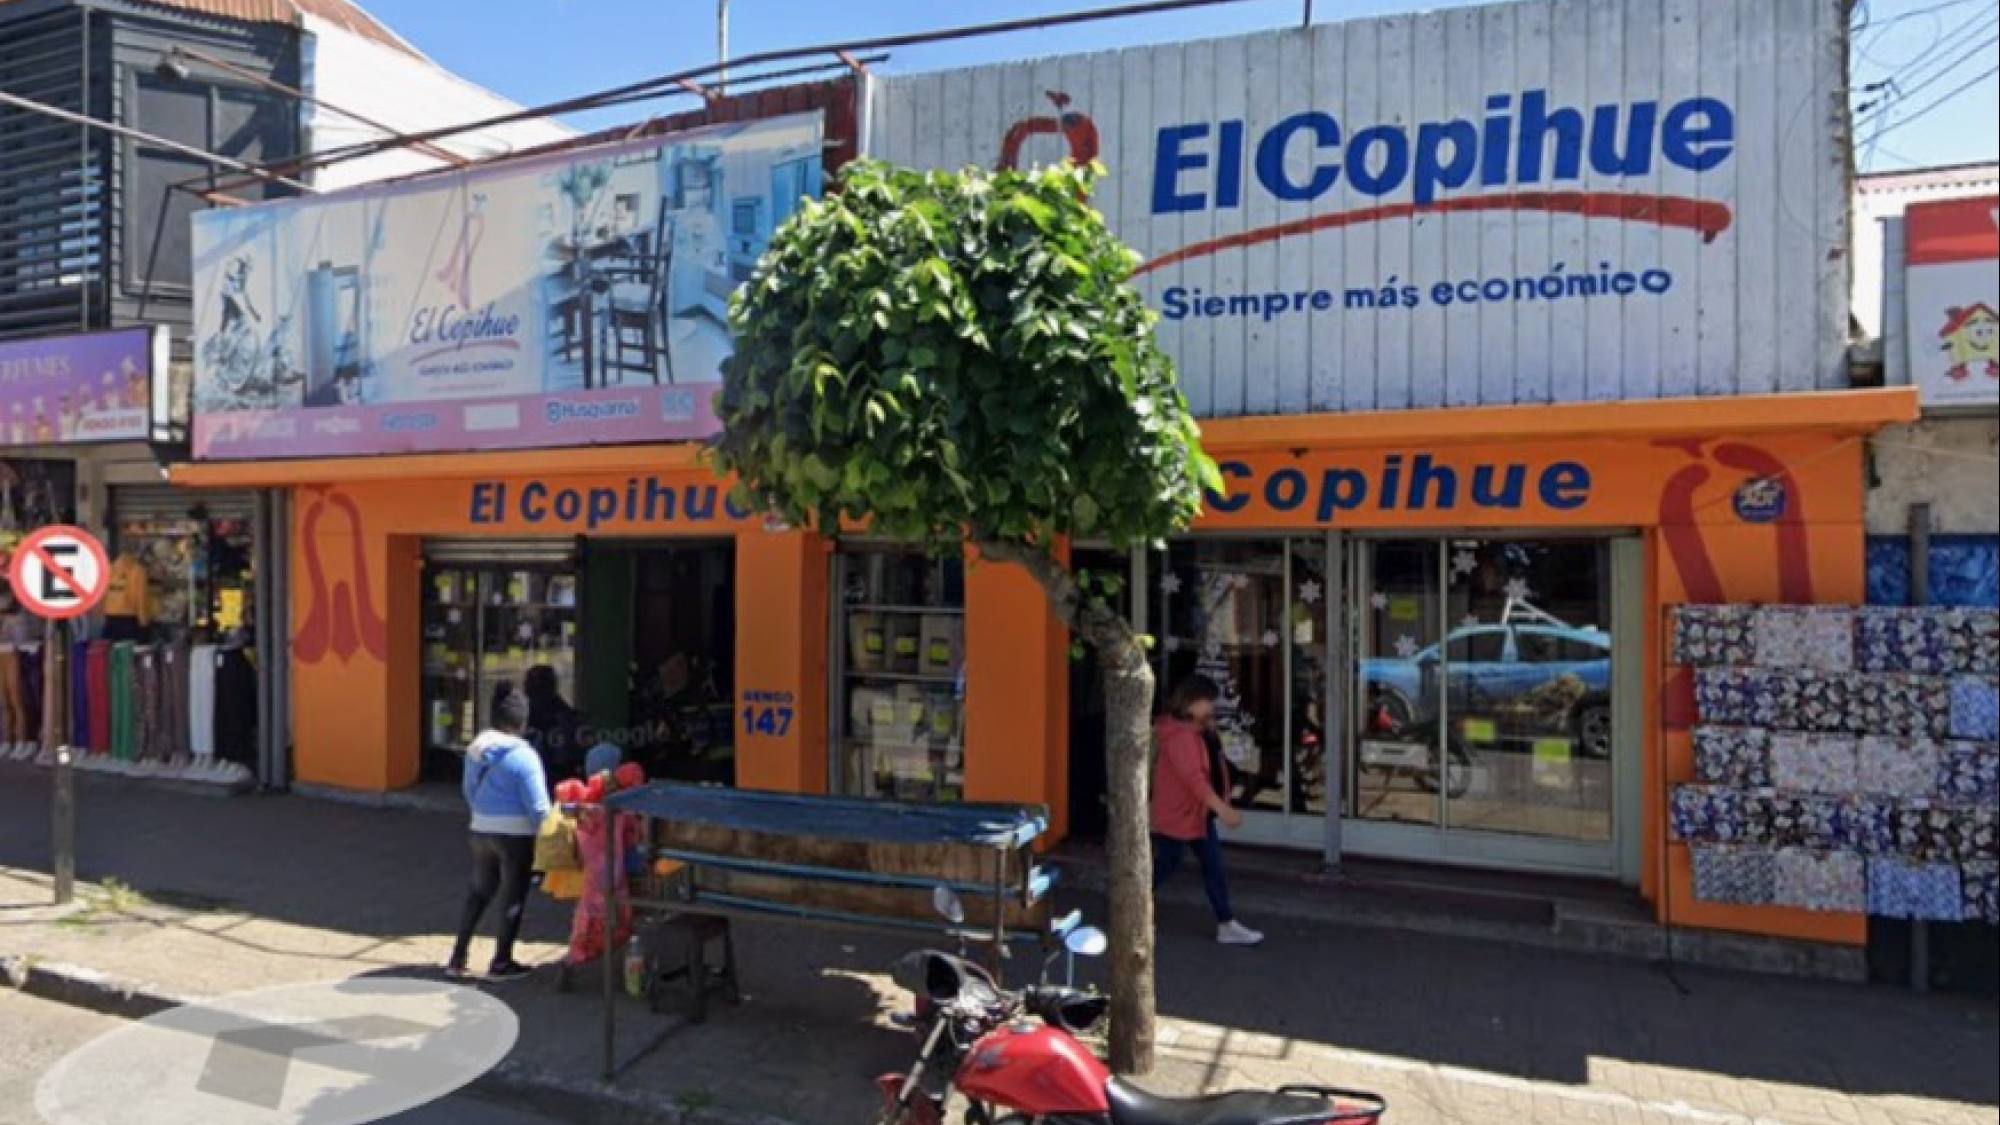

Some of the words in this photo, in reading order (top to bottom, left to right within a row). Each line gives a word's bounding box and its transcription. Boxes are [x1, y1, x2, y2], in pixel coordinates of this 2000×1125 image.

[1149, 118, 1244, 216] El
[1254, 88, 1735, 204] Copihue
[1160, 285, 1333, 323] Siempre
[1343, 275, 1421, 311] más
[1430, 261, 1674, 309] económico
[469, 481, 507, 523] El
[1203, 454, 1591, 522] Copihue
[40, 543, 79, 600] E
[743, 704, 794, 737] 147
